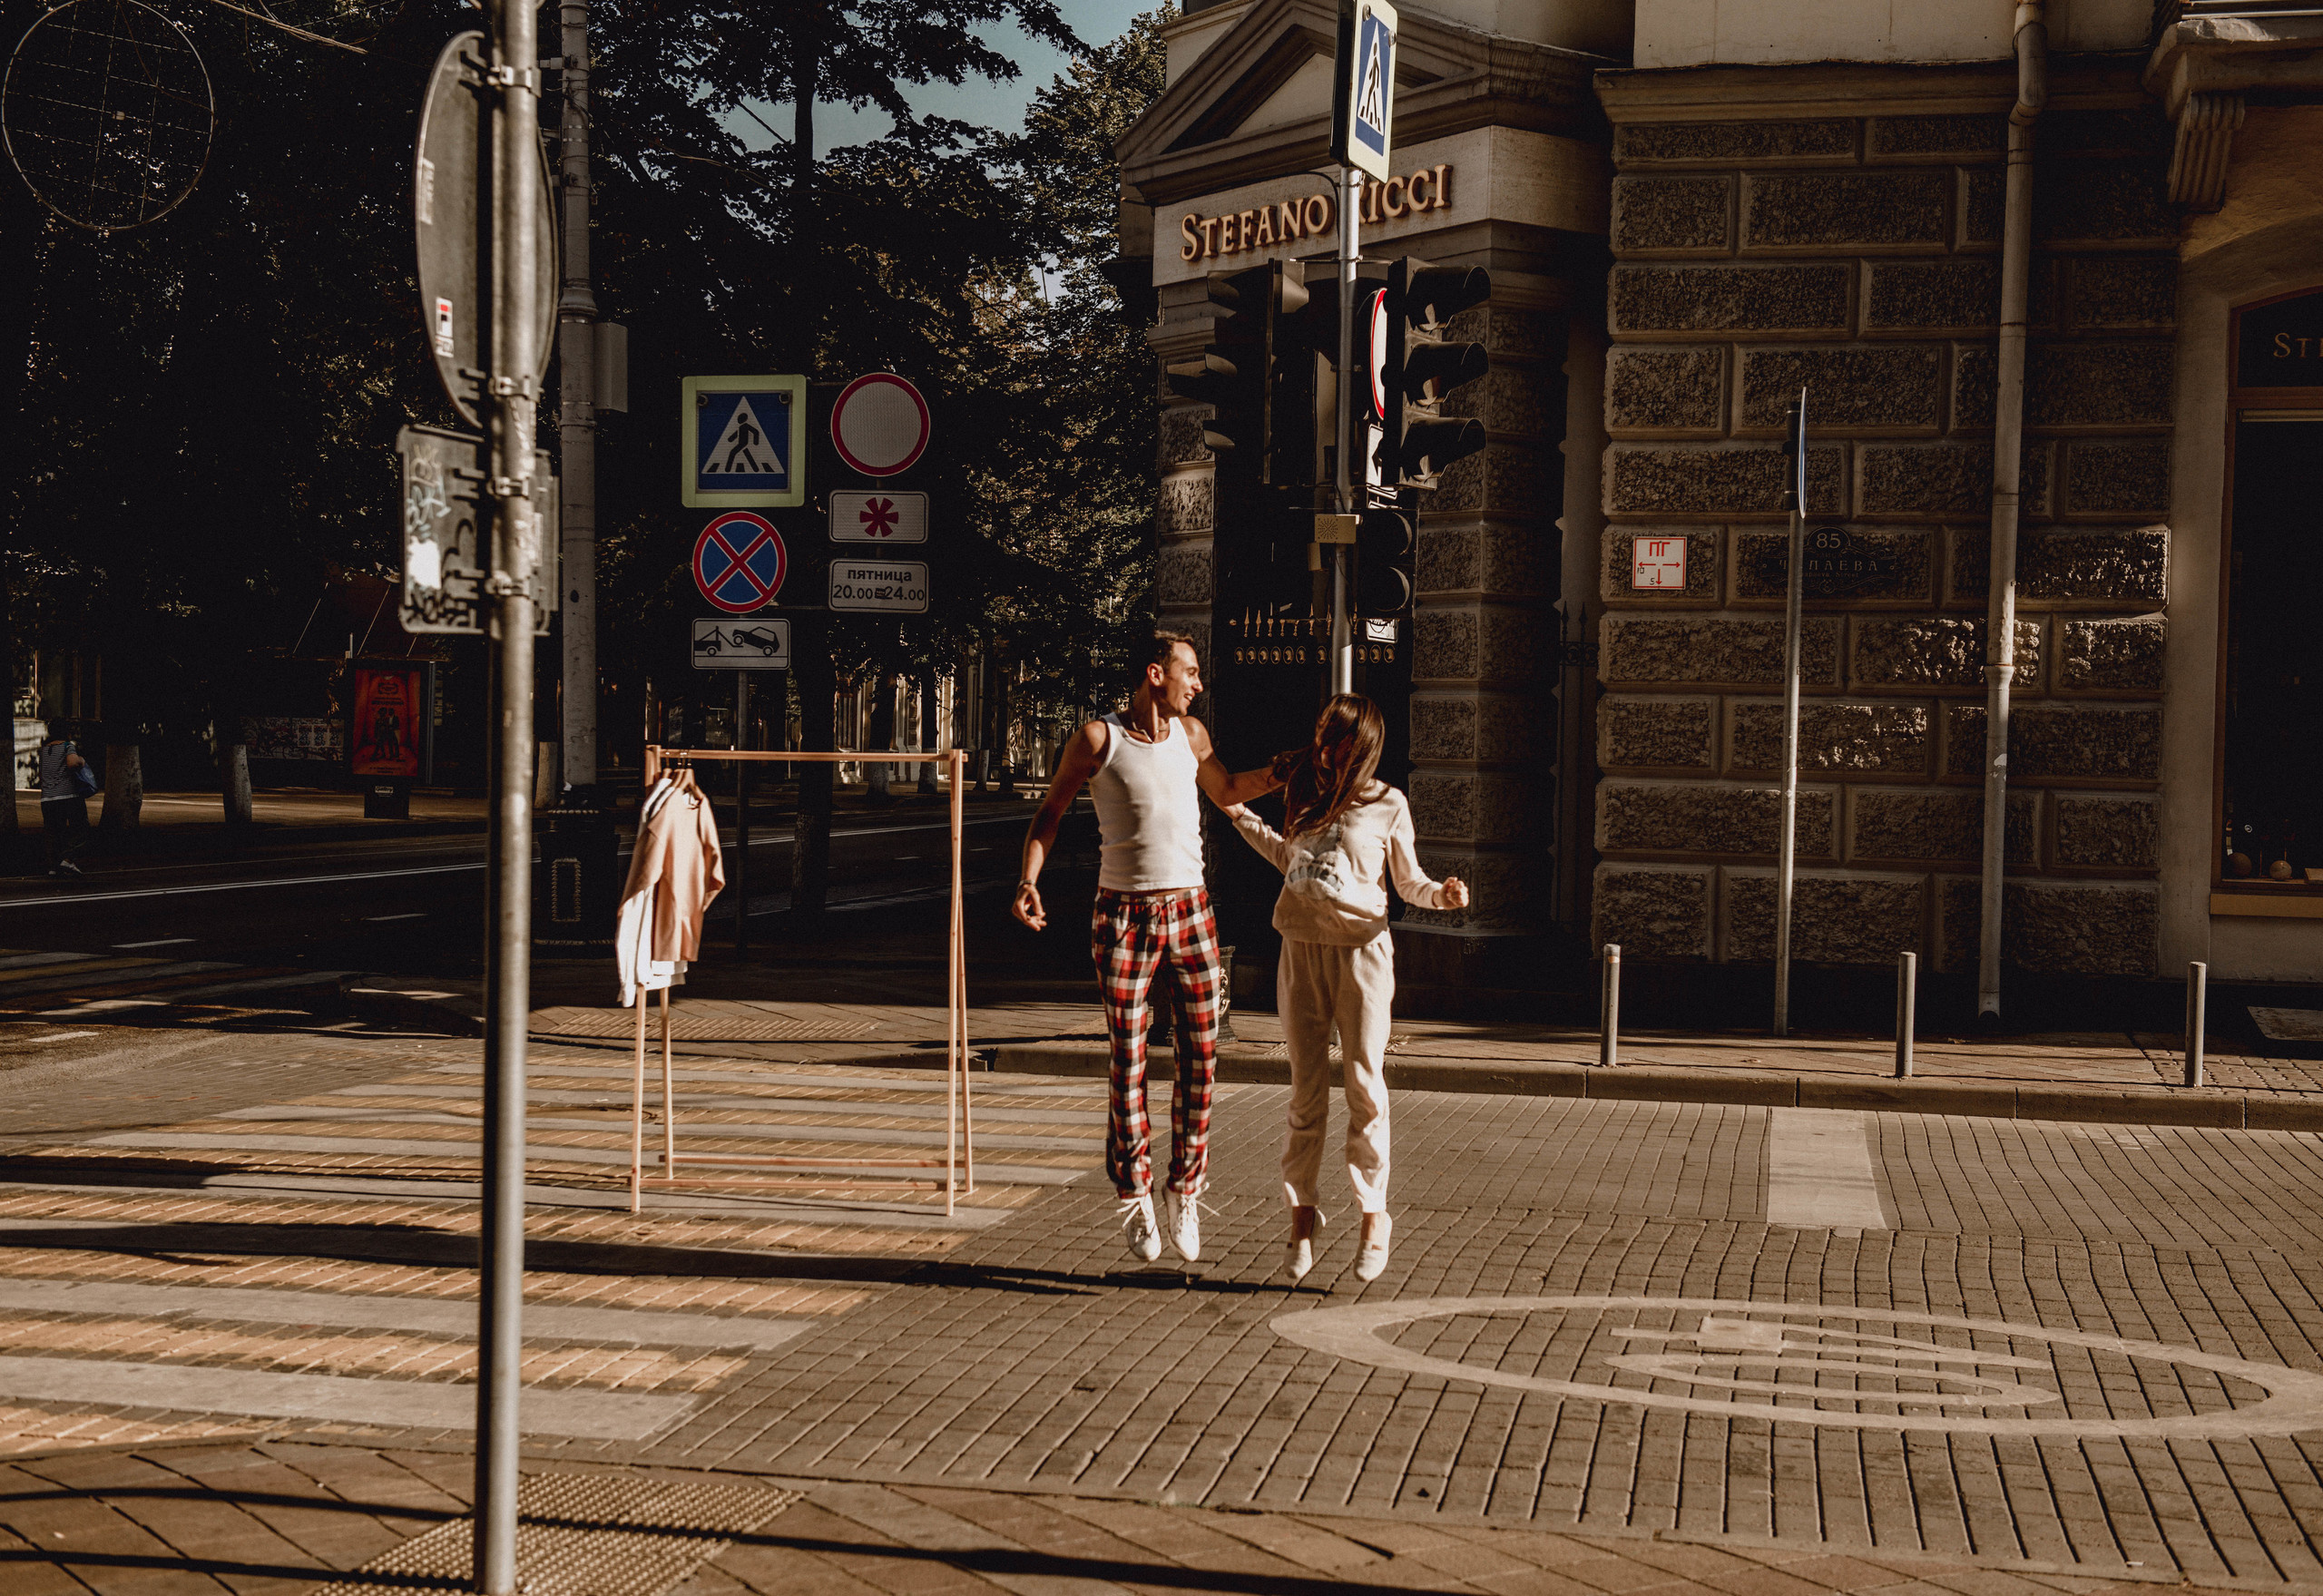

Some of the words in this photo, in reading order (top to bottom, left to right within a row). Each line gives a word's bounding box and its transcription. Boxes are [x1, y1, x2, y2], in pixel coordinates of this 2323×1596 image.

[1180, 194, 1334, 261] STEFANO
[1816, 533, 1841, 549] 85
[1649, 542, 1671, 557] ПГ
[1779, 559, 1878, 572] ЧПАЕВА
[848, 569, 912, 583] пятница
